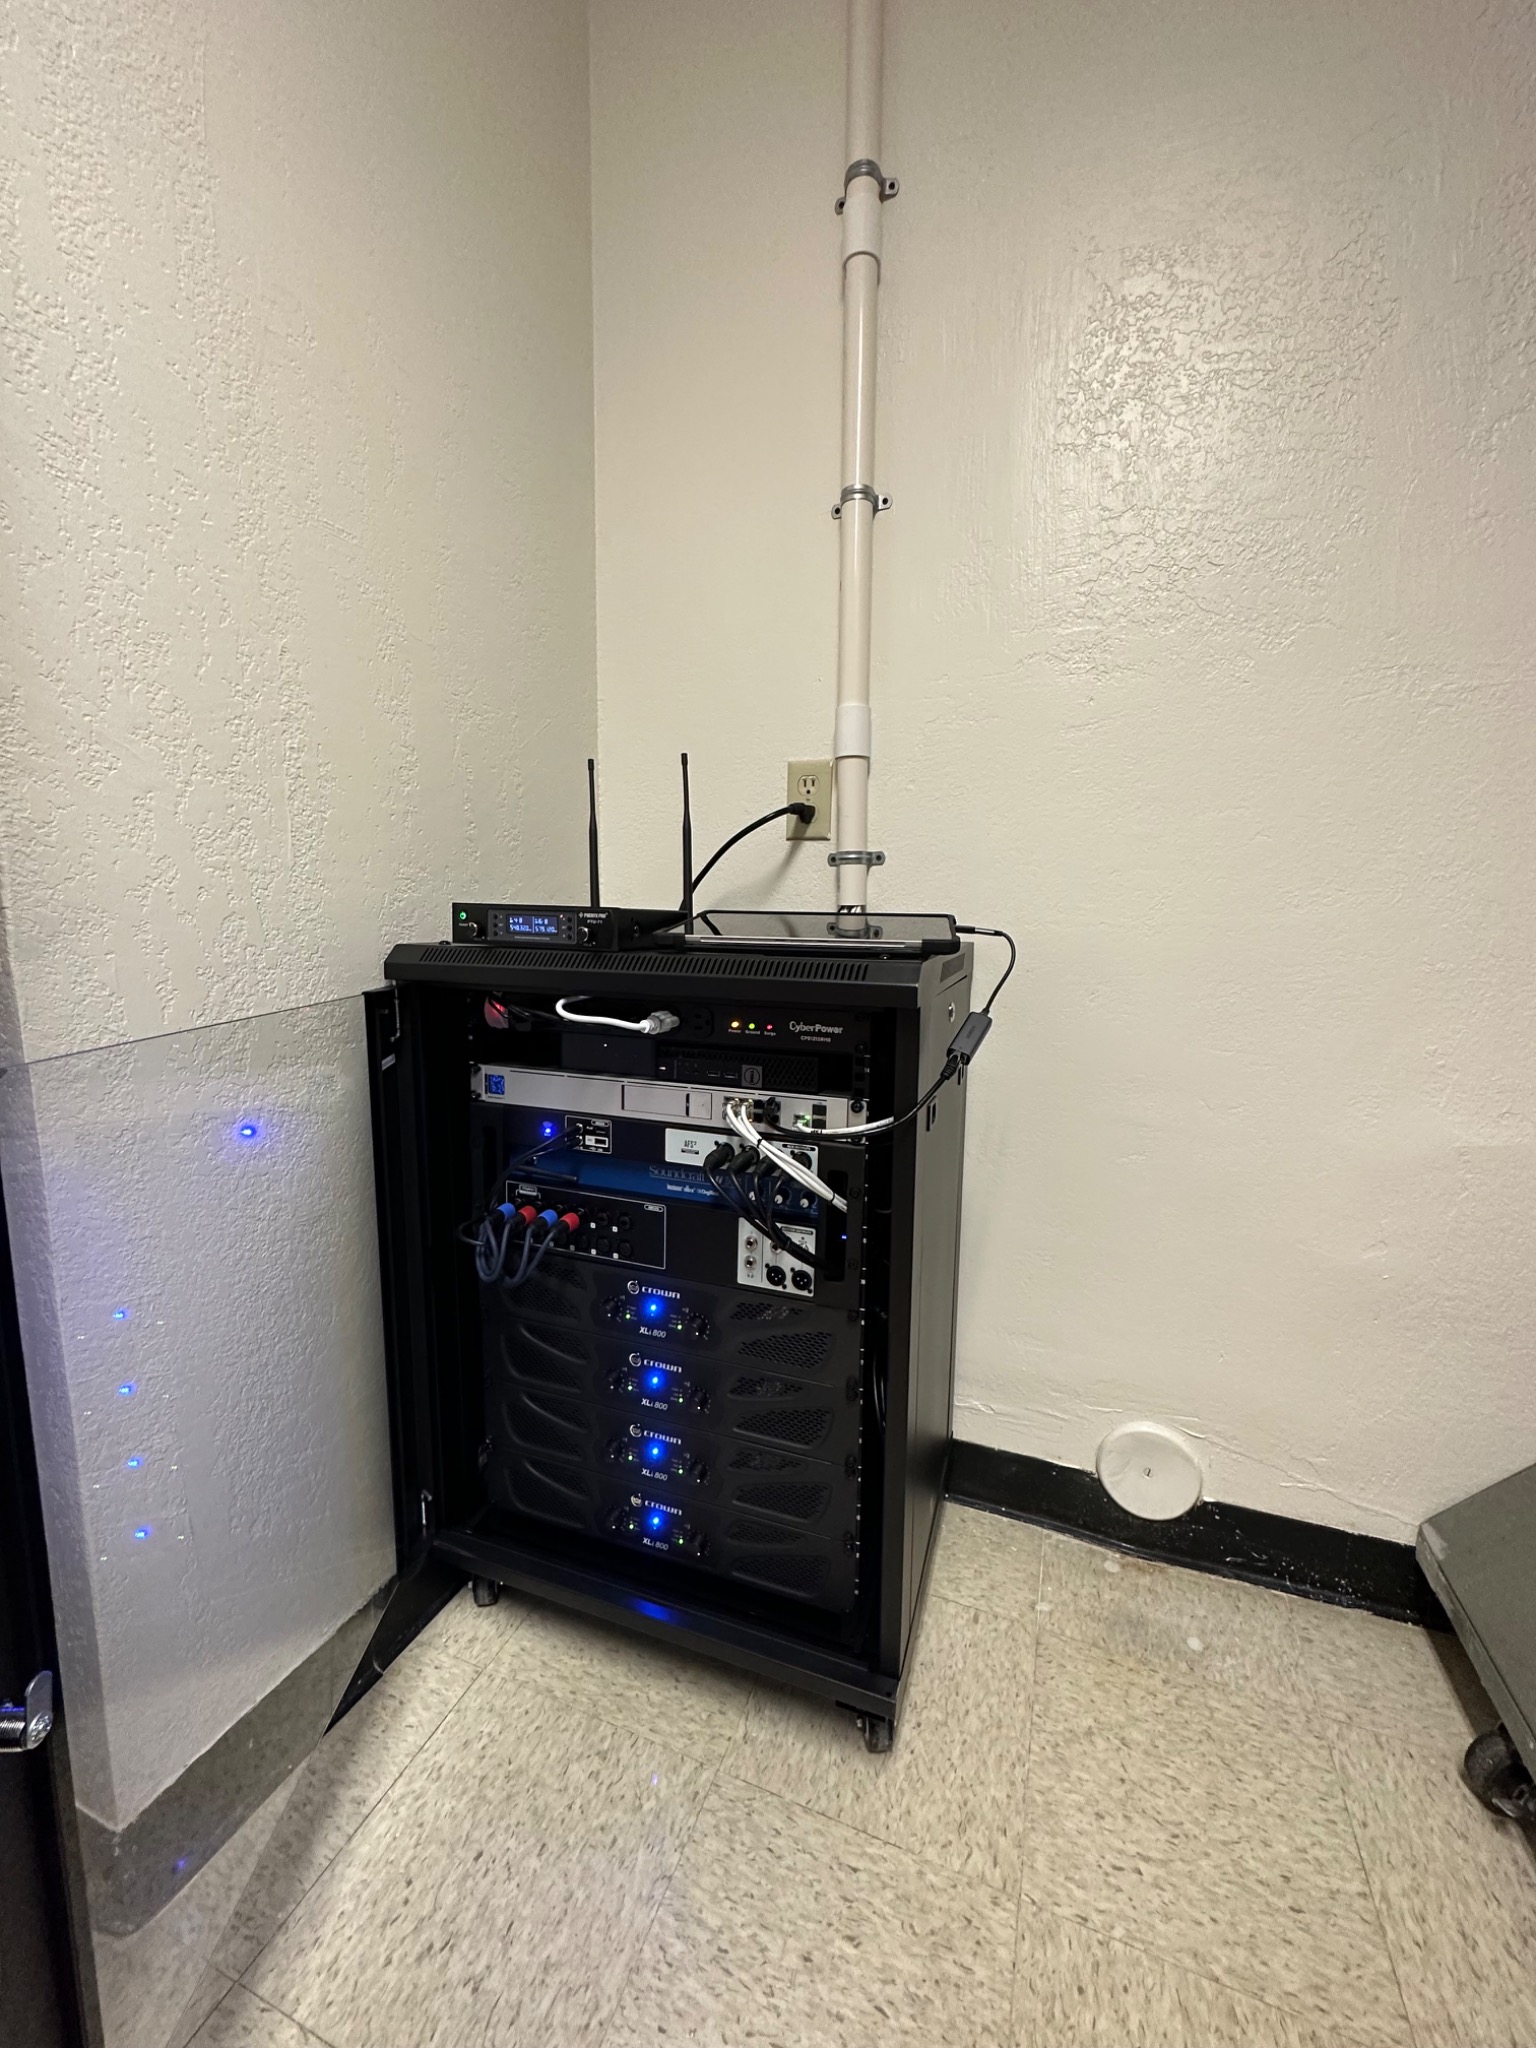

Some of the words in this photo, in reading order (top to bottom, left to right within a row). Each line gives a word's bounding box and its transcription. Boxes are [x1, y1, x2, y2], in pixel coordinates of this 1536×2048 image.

[789, 1021, 844, 1034] CyberPower
[641, 1286, 681, 1299] crown
[639, 1326, 652, 1336] XLi
[652, 1328, 667, 1338] 800
[643, 1359, 682, 1373] crown
[641, 1398, 653, 1407] XLi
[654, 1399, 668, 1410] 800
[643, 1430, 682, 1445] crown
[641, 1468, 653, 1477] XLi
[654, 1470, 668, 1481] 800
[644, 1500, 682, 1516] crown
[642, 1537, 654, 1547] XLi
[655, 1539, 669, 1551] 800
